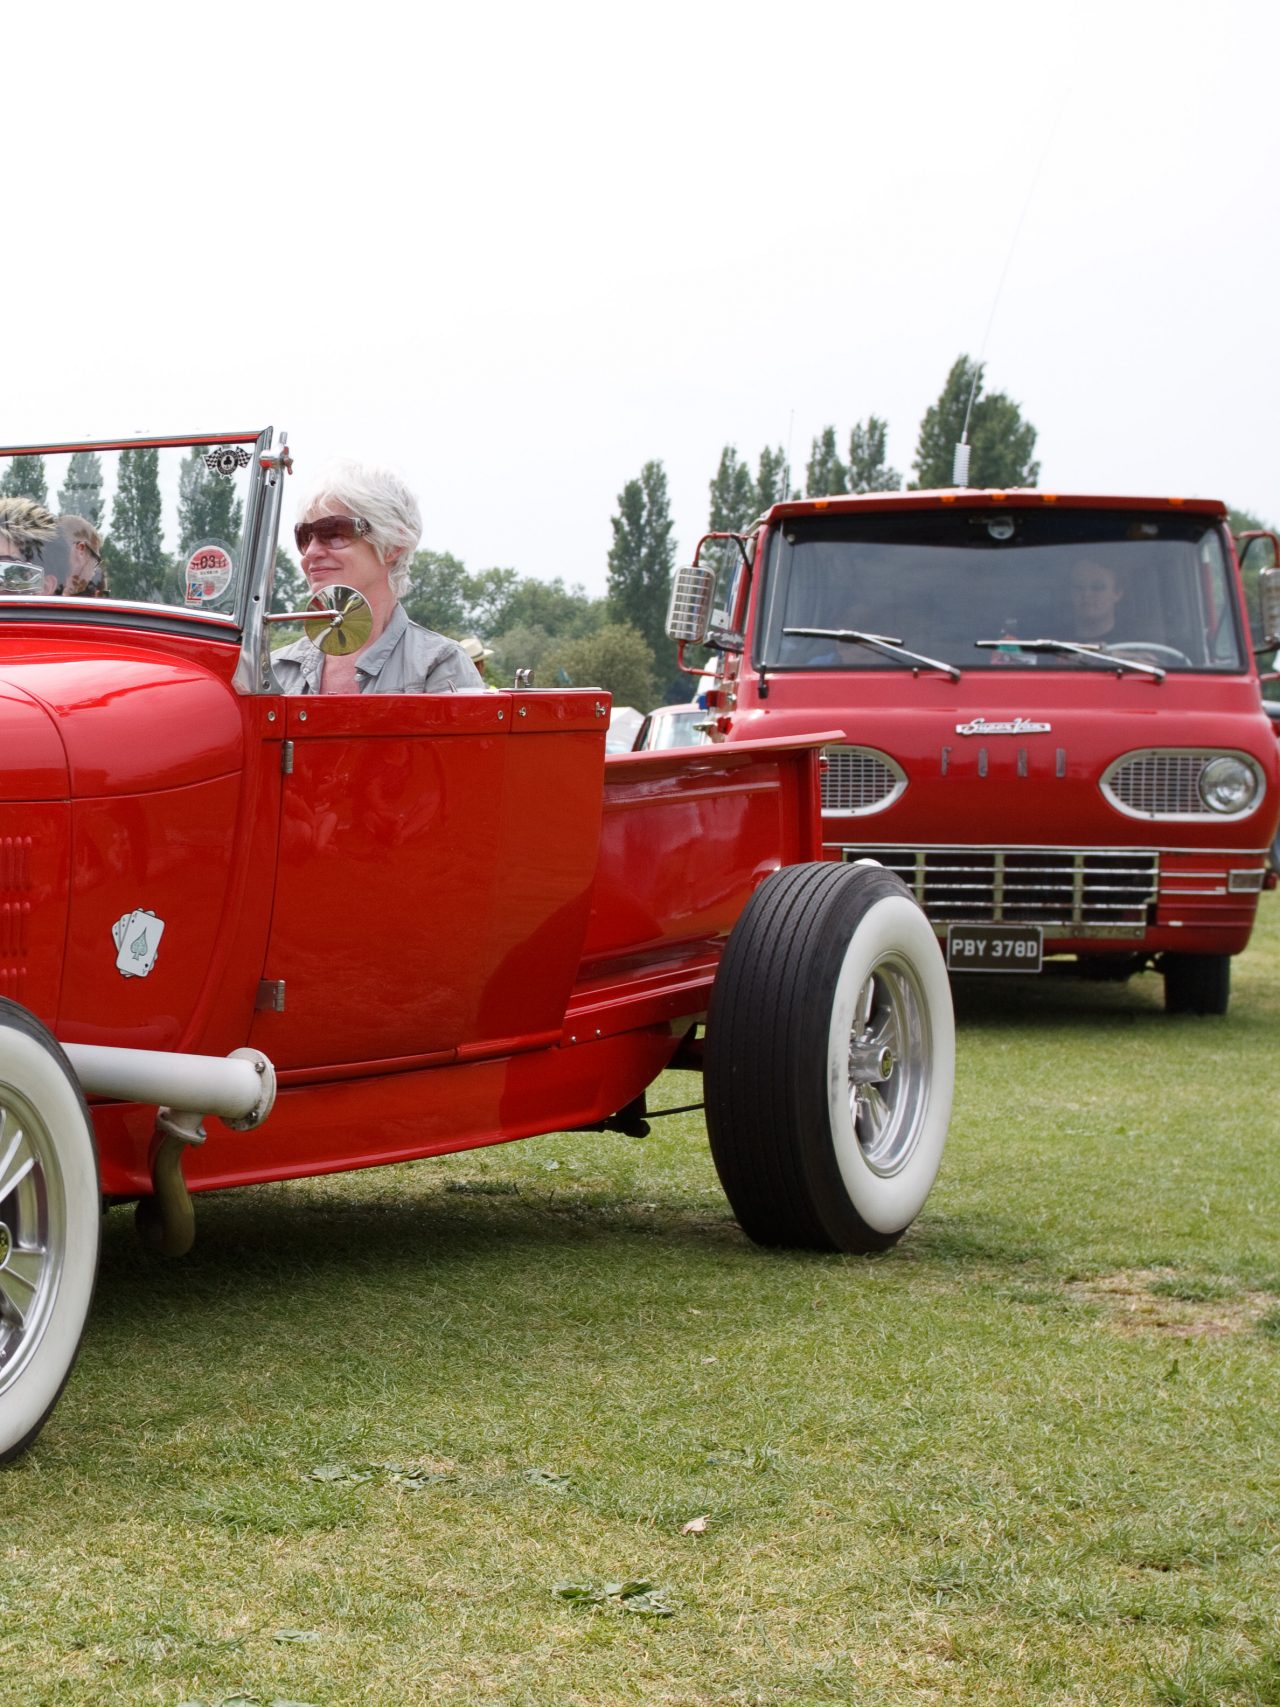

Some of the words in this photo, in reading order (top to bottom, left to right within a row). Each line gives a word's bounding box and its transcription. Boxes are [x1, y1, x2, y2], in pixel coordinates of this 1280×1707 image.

[200, 555, 216, 569] 03
[951, 939, 987, 957] PBY
[991, 940, 1038, 958] 378D
